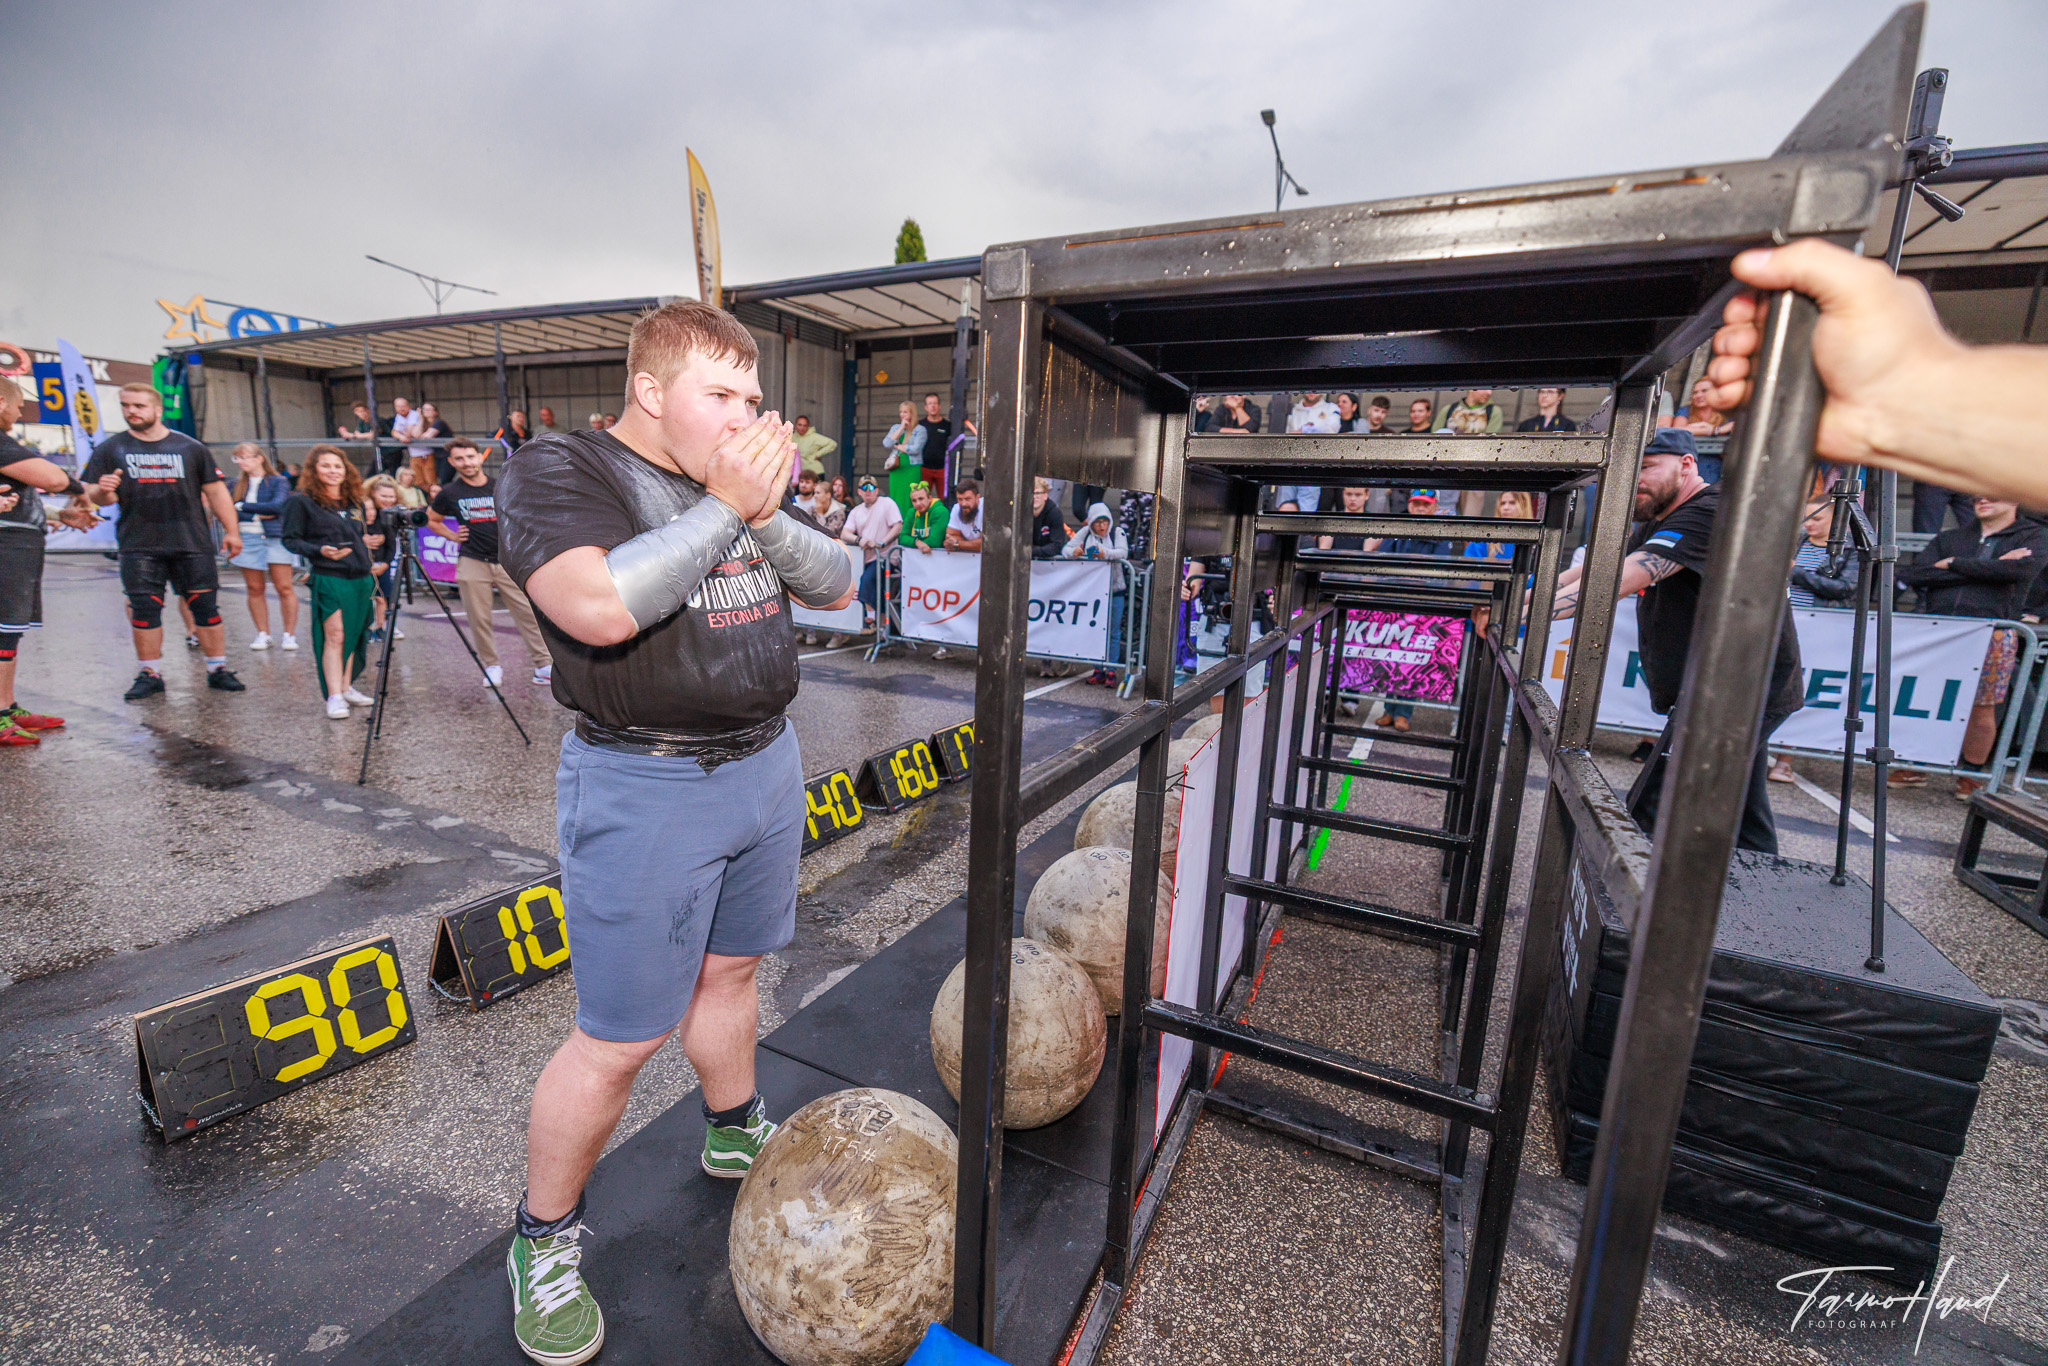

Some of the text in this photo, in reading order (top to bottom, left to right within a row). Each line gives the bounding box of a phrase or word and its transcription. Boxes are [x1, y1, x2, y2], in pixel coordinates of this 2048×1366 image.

[43, 377, 64, 411] 5
[721, 560, 744, 577] PRO
[707, 606, 764, 629] ESTONIA
[907, 586, 1101, 627] POP ORT!
[1344, 620, 1440, 651] KUM.EE
[1344, 647, 1426, 663] EKLAAM
[889, 741, 939, 799] 160
[806, 771, 863, 840] 140
[245, 946, 408, 1083] 90
[821, 1135, 876, 1163] 175#
